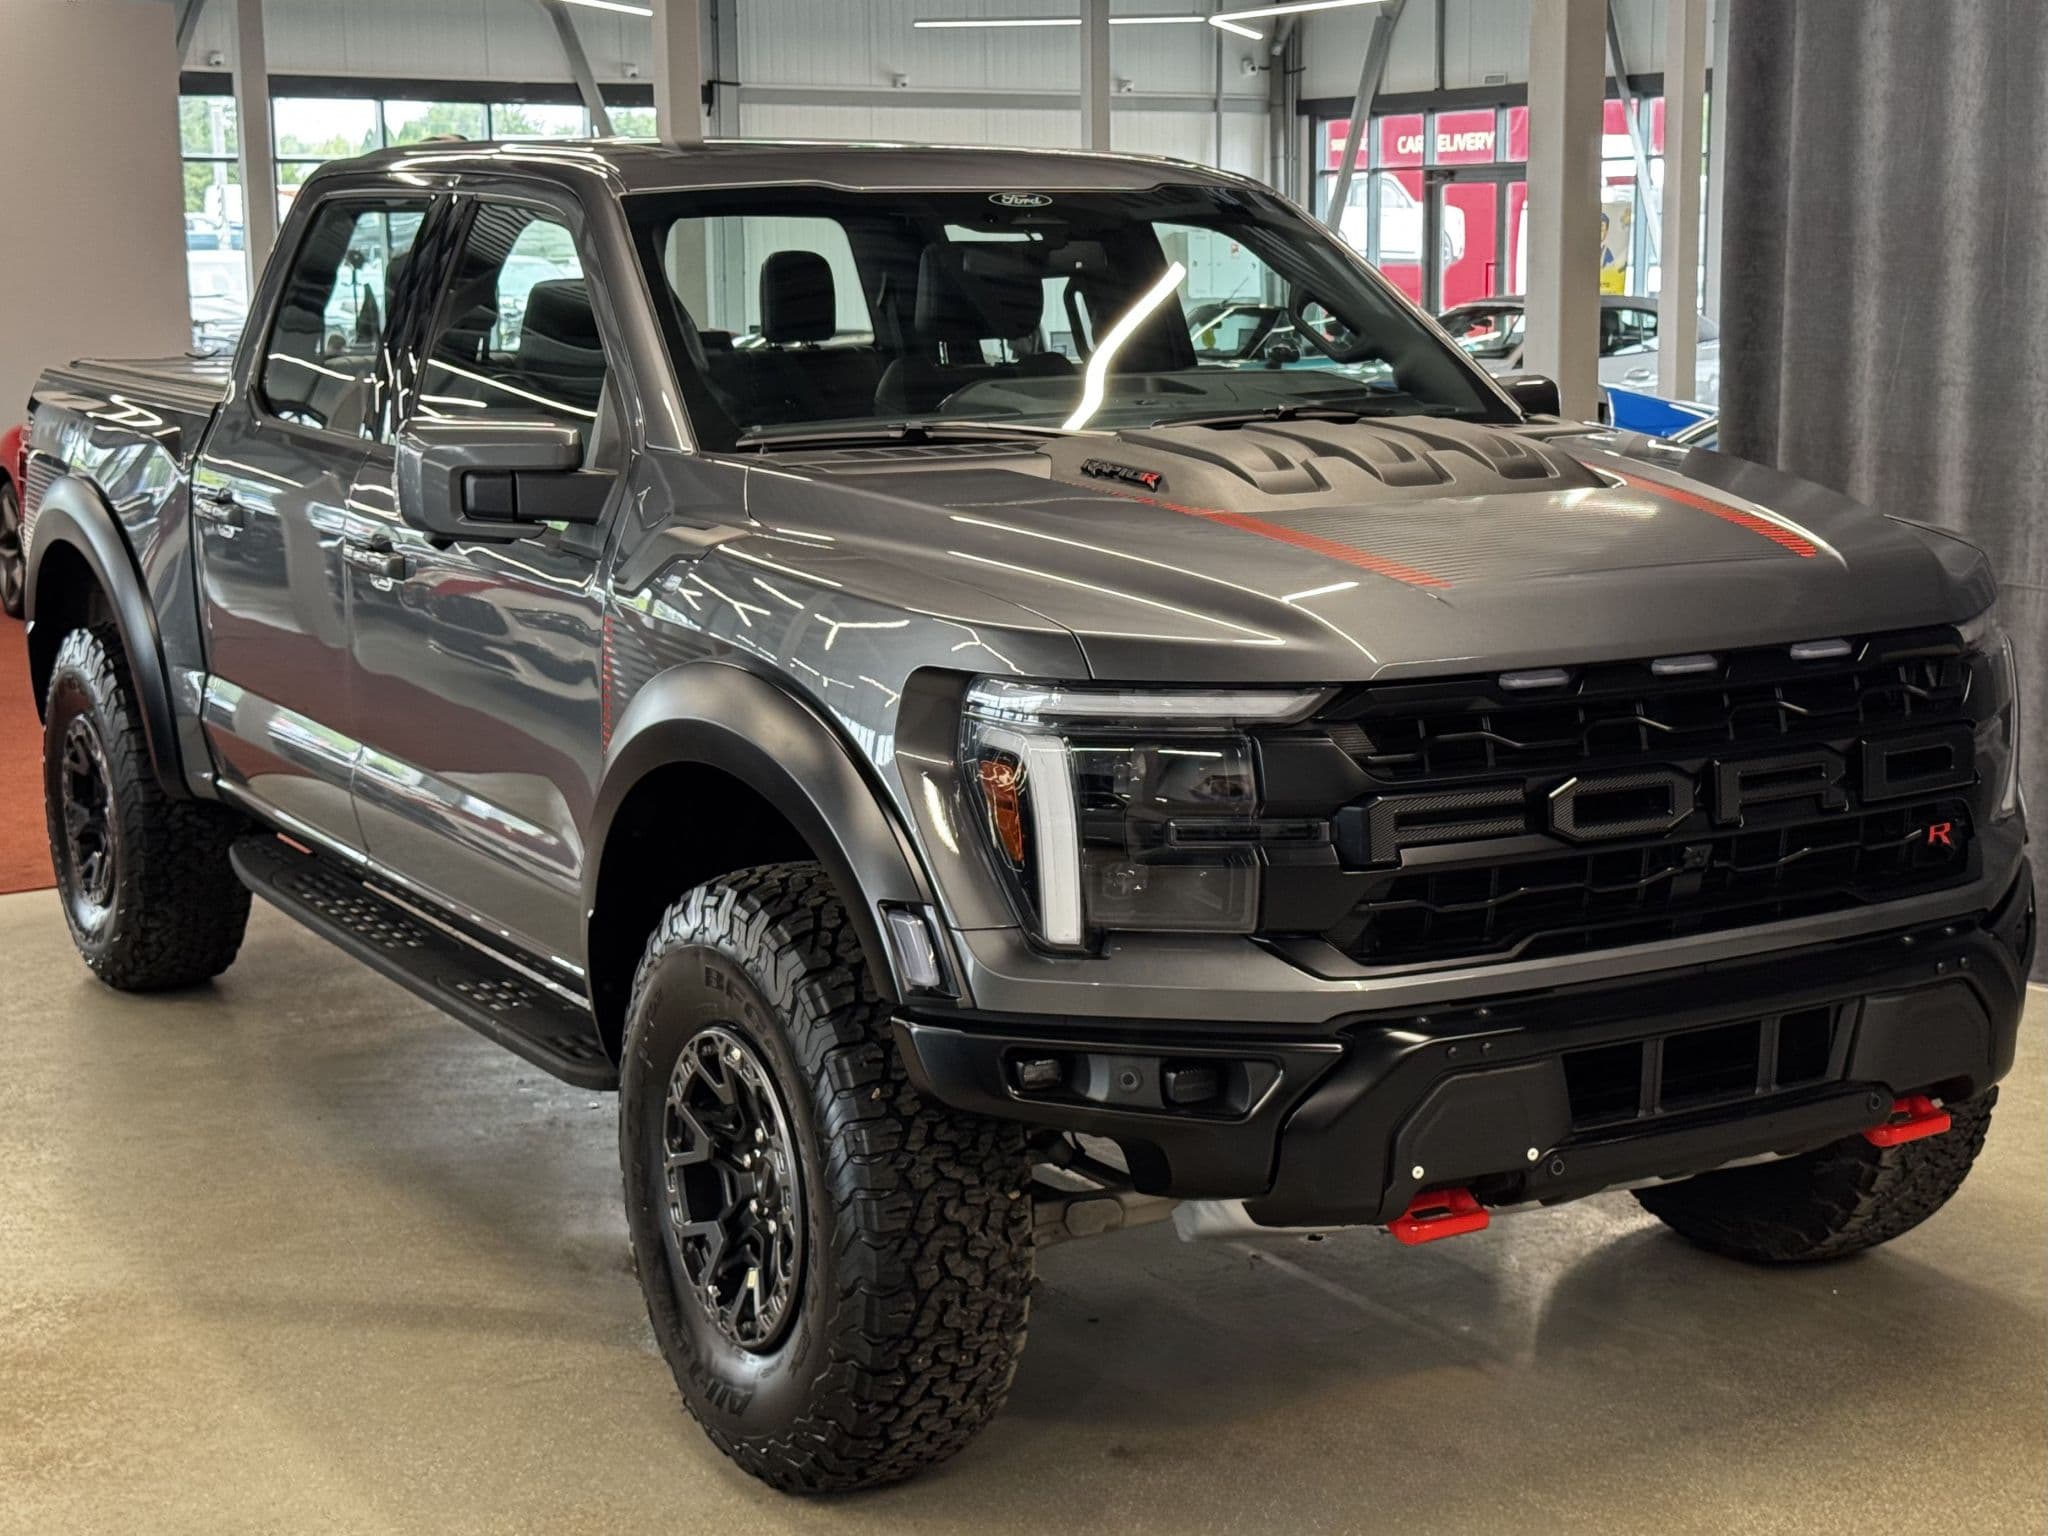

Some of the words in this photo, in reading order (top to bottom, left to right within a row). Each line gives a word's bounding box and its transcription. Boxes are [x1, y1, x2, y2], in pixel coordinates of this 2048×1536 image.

[1397, 134, 1424, 154] CAR
[1436, 129, 1495, 152] ELIVERY
[1362, 734, 1977, 868] FORD
[1928, 822, 1951, 845] R
